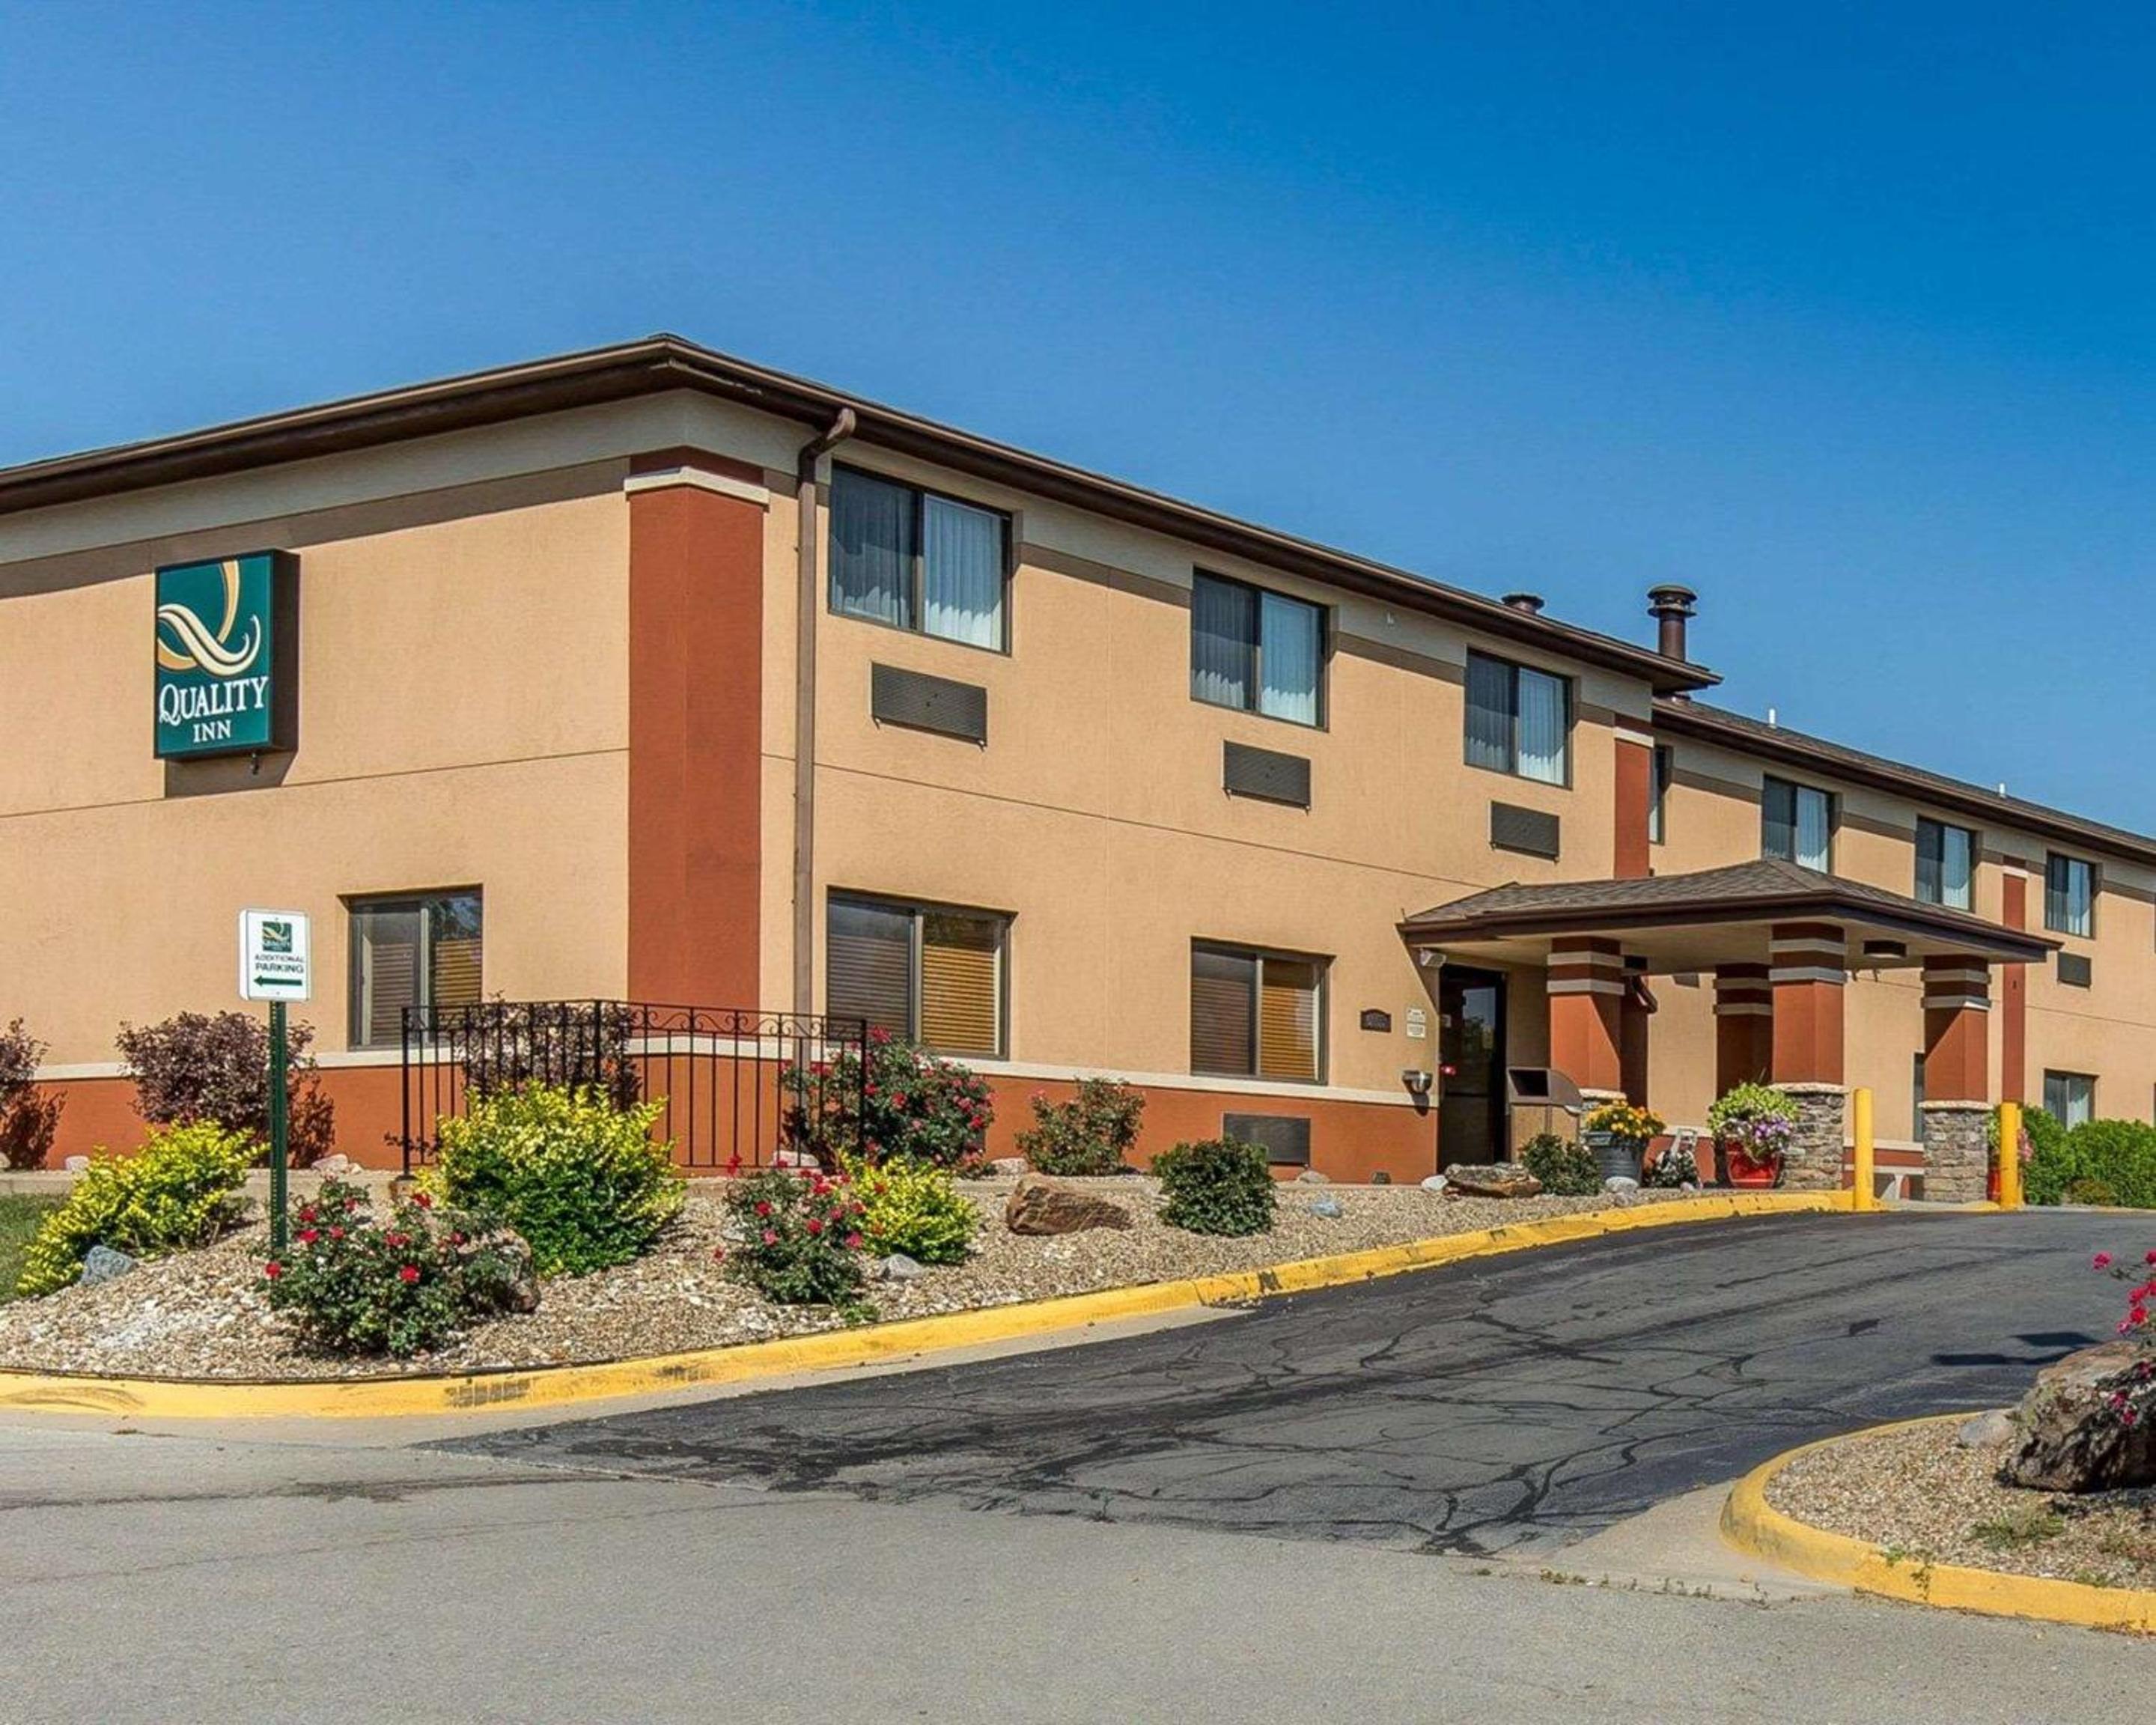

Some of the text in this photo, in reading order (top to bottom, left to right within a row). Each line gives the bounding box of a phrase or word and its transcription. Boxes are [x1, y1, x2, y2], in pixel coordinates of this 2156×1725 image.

[159, 675, 269, 726] QUALITY
[193, 719, 231, 743] INN
[255, 962, 304, 973] PARKING
